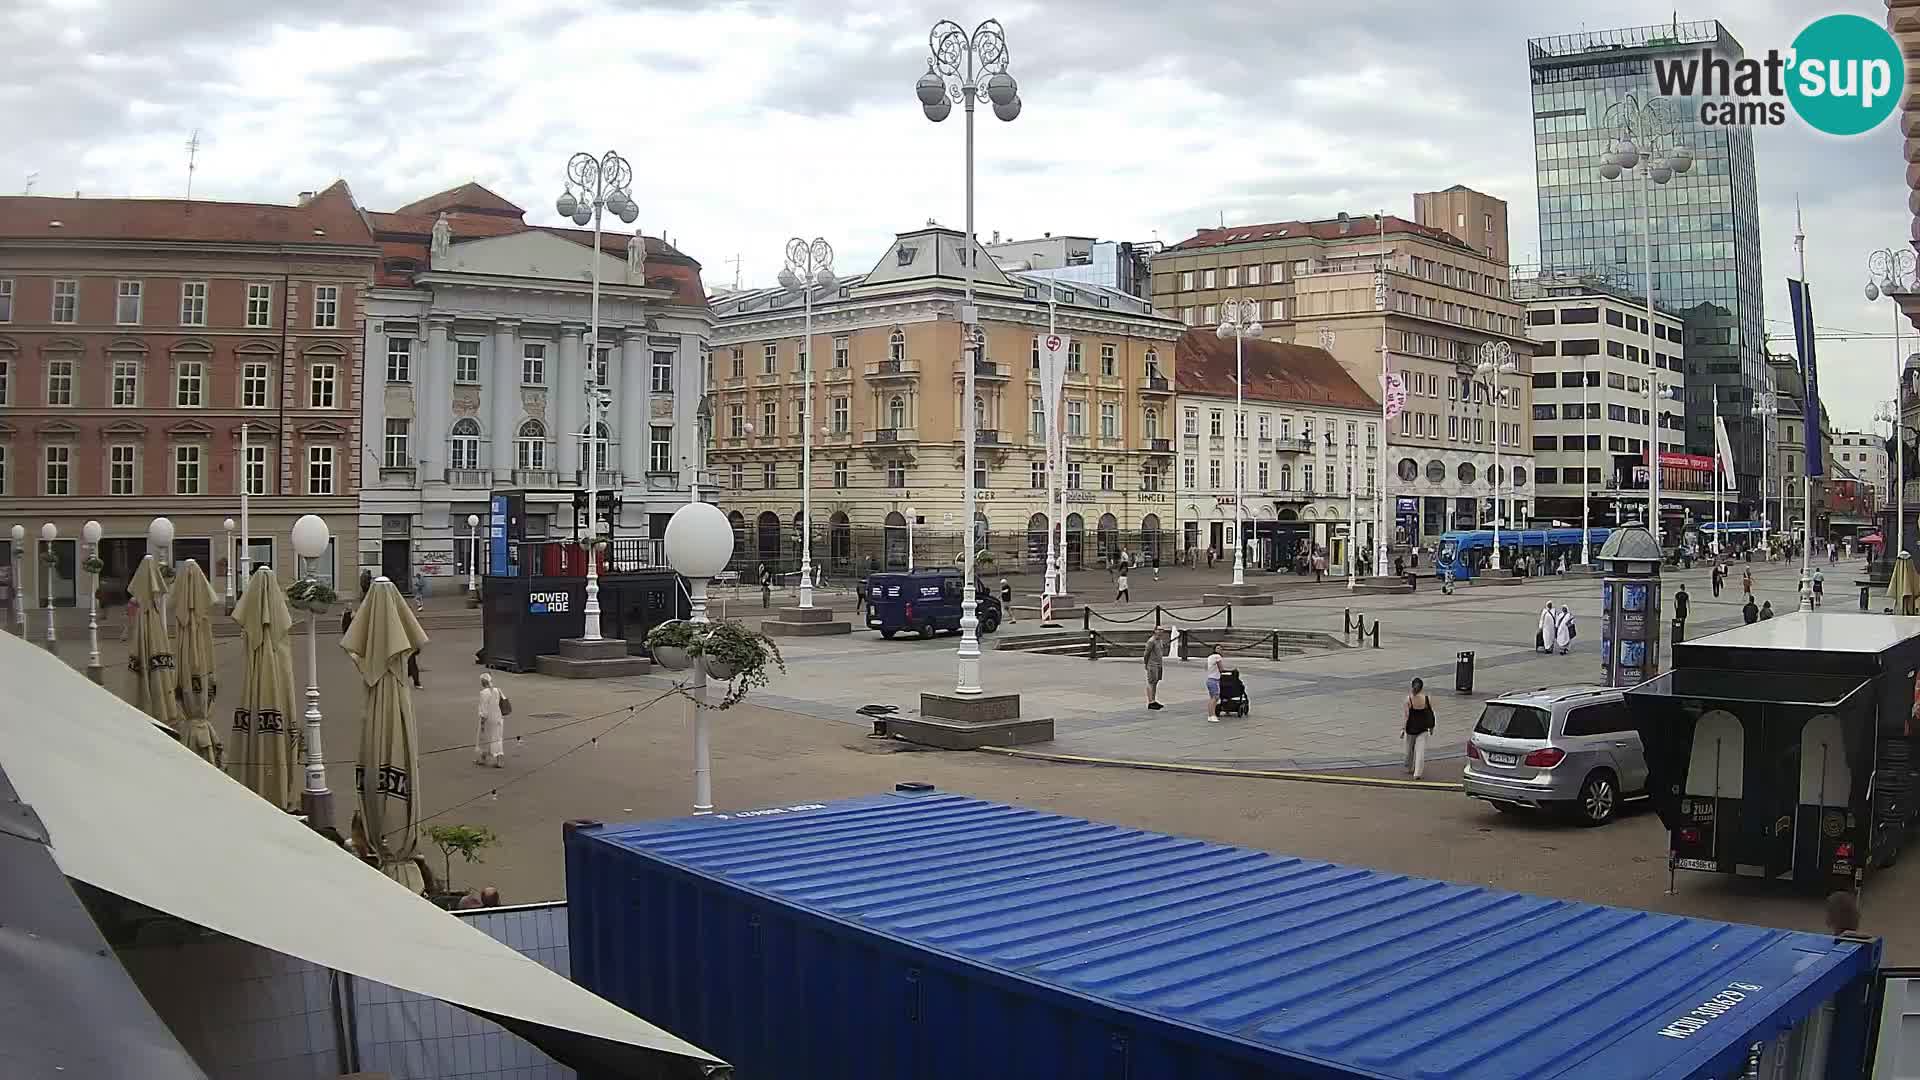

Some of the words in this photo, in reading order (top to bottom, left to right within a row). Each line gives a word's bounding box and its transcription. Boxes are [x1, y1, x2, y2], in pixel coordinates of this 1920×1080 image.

[530, 592, 569, 603] POWER
[547, 602, 569, 612] ADE
[1657, 1016, 1709, 1039] MCDU
[1691, 990, 1747, 1018] 300629
